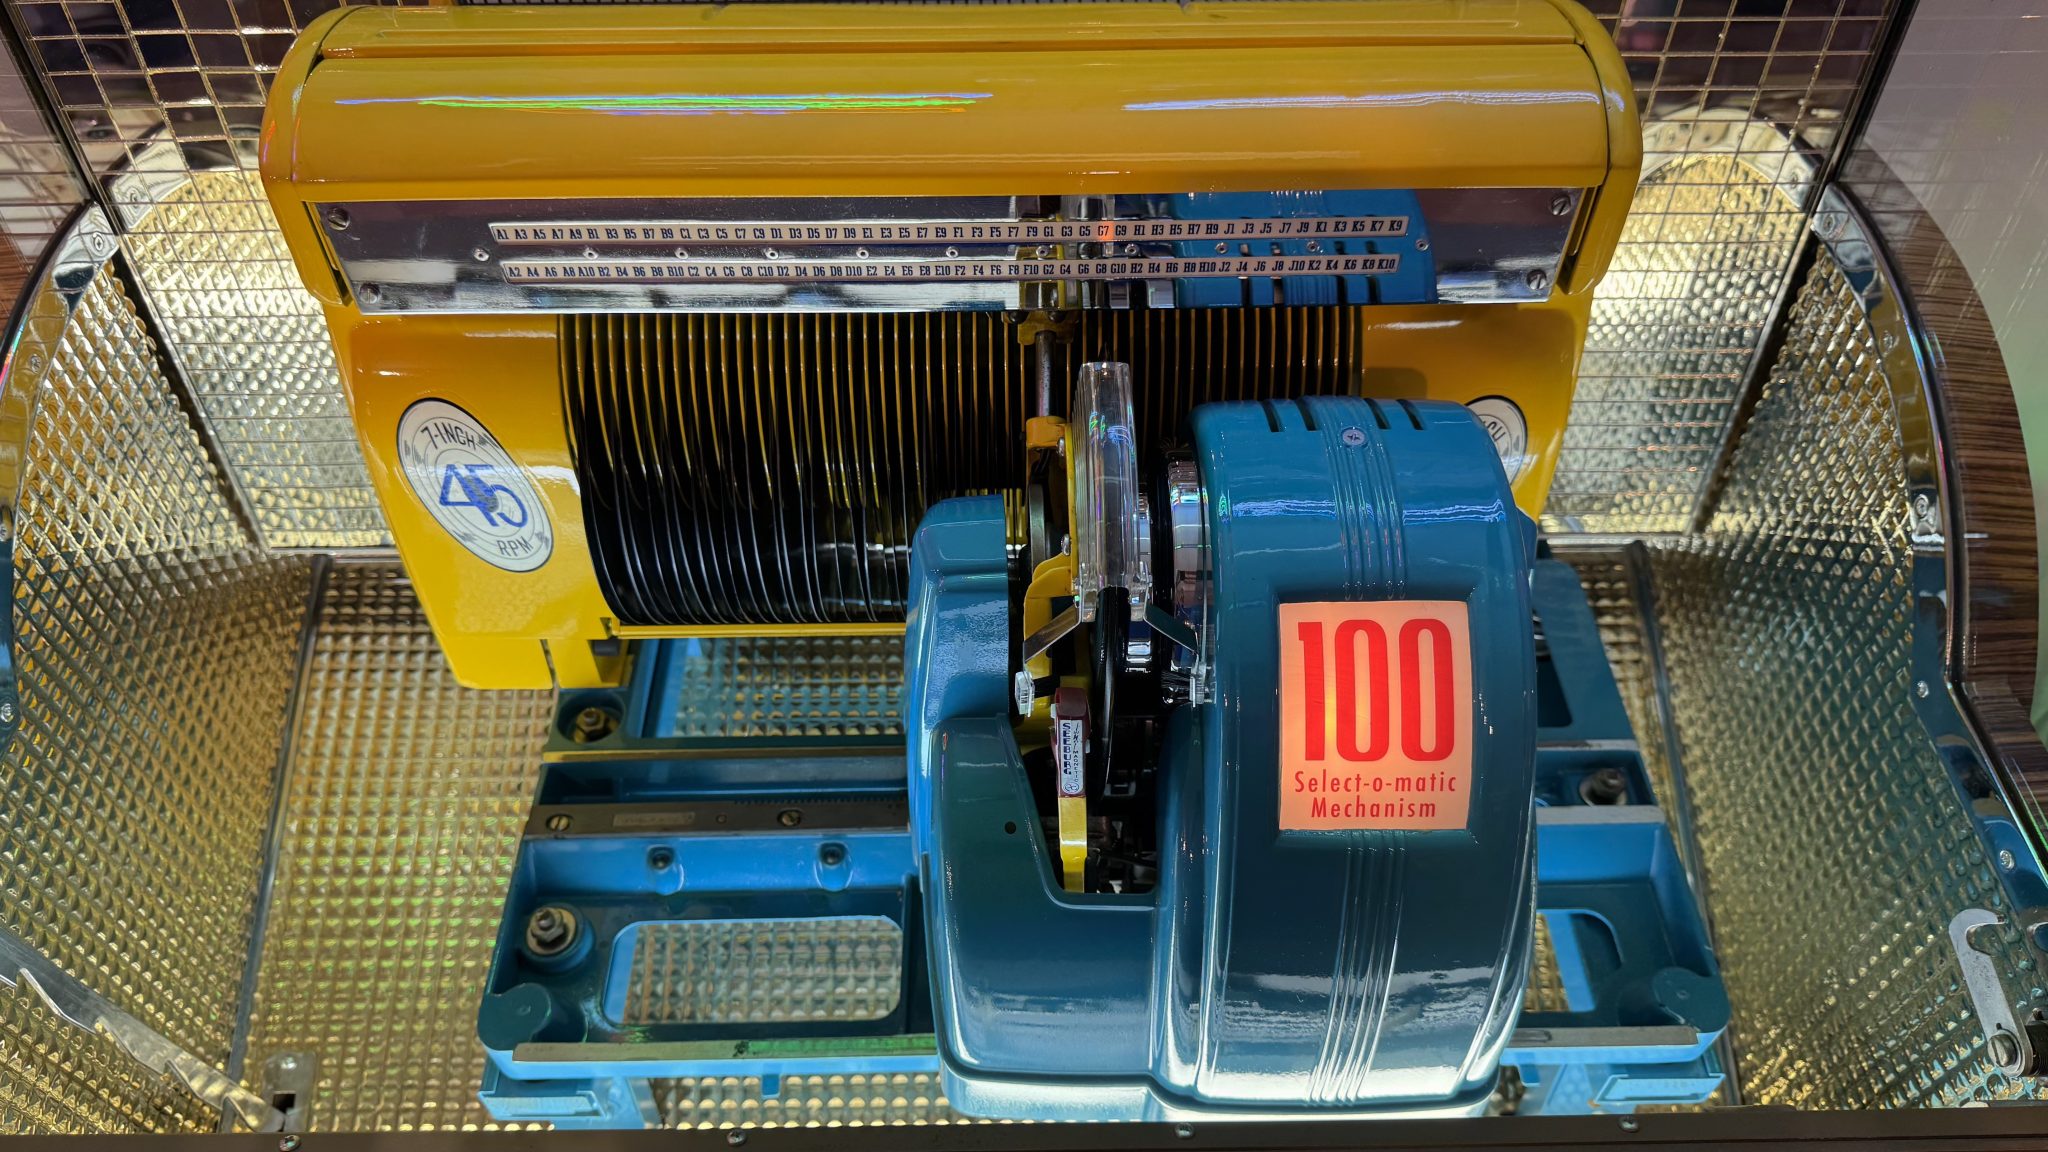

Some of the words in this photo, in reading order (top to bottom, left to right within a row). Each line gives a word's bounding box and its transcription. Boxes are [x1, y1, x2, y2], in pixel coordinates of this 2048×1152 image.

[496, 228, 509, 240] A1
[514, 228, 528, 239] A3
[532, 228, 546, 239] A5
[551, 228, 563, 239] A7
[568, 228, 582, 239] A9
[586, 228, 600, 239] B1
[604, 227, 619, 239] B3
[622, 228, 637, 239] B5
[641, 227, 654, 239] B7
[659, 227, 674, 239] B9
[679, 227, 692, 239] C1
[696, 227, 710, 239] C3
[715, 227, 728, 239] C5
[734, 227, 746, 239] C7
[752, 227, 765, 239] C9
[769, 227, 783, 239] D1
[788, 227, 802, 238] D3
[806, 227, 820, 238] D5
[824, 227, 837, 239] D7
[842, 227, 856, 238] D9
[861, 227, 873, 238] E1
[879, 226, 892, 238] E3
[898, 226, 910, 238] E5
[916, 226, 928, 238] E7
[934, 226, 947, 238] E9
[952, 226, 963, 238] F1
[971, 226, 983, 238] F3
[989, 226, 1001, 237] F5
[1007, 226, 1019, 237] F7
[1026, 225, 1038, 237] F9
[1043, 225, 1054, 237] G1
[1060, 225, 1072, 237] G3
[1078, 225, 1090, 236] G5
[1097, 225, 1109, 236] G7
[1114, 224, 1127, 236] G9
[1133, 224, 1145, 236] H1
[1150, 224, 1164, 235] H3
[1168, 223, 1182, 235] H5
[1186, 223, 1201, 235] H7
[1204, 223, 1219, 234] H9
[1223, 222, 1235, 234] J1
[1241, 222, 1254, 234] J3
[1259, 222, 1272, 233] J5
[1278, 221, 1292, 233] J7
[1296, 221, 1310, 233] J9
[1314, 220, 1328, 232] K1
[1332, 220, 1347, 232] K3
[1350, 220, 1365, 232] K5
[1369, 220, 1384, 232] K7
[1388, 219, 1402, 231] K9
[508, 266, 522, 277] A2
[526, 266, 539, 277] A4
[544, 266, 558, 277] A6
[562, 266, 576, 277] A8
[577, 266, 595, 277] A10
[596, 266, 611, 277] B2
[614, 266, 628, 276] B4
[632, 266, 646, 277] B6
[650, 266, 664, 277] B8
[666, 265, 684, 277] B10
[687, 266, 700, 277] C2
[704, 265, 718, 277] C4
[722, 265, 736, 277] C6
[740, 265, 753, 277] C8
[757, 265, 774, 277] C10
[776, 265, 790, 276] D2
[794, 265, 808, 276] D4
[812, 265, 826, 277] D6
[829, 265, 843, 276] D8
[844, 265, 862, 276] D10
[865, 265, 878, 276] E2
[883, 265, 895, 276] E4
[901, 265, 913, 276] E6
[918, 265, 931, 276] E8
[934, 265, 950, 276] E10
[954, 264, 966, 276] F2
[972, 264, 984, 275] F4
[990, 264, 1002, 275] F6
[1008, 264, 1020, 275] F8
[1023, 264, 1039, 275] F10
[1042, 263, 1054, 275] G2
[1059, 263, 1071, 275] G4
[1077, 263, 1089, 275] G6
[1095, 262, 1107, 274] G8
[1110, 262, 1126, 274] G10
[1129, 262, 1143, 273] H2
[1147, 262, 1160, 273] H4
[1165, 262, 1178, 273] H6
[1182, 261, 1196, 272] H8
[1198, 261, 1216, 272] H10
[1218, 260, 1231, 272] J2
[1235, 260, 1248, 272] J4
[1253, 260, 1266, 271] J6
[1271, 260, 1284, 271] J8
[1287, 260, 1305, 271] J10
[1307, 259, 1321, 270] K2
[1324, 259, 1339, 270] K4
[1342, 258, 1357, 270] K6
[1360, 258, 1375, 270] K8
[1376, 258, 1396, 269] K10
[439, 464, 528, 528] 45
[496, 536, 534, 556] RPM
[1298, 618, 1454, 762] 100
[1062, 722, 1072, 775] SEEBURG
[1294, 769, 1457, 792] Select-o-matic
[1312, 795, 1436, 818] Mechanism
